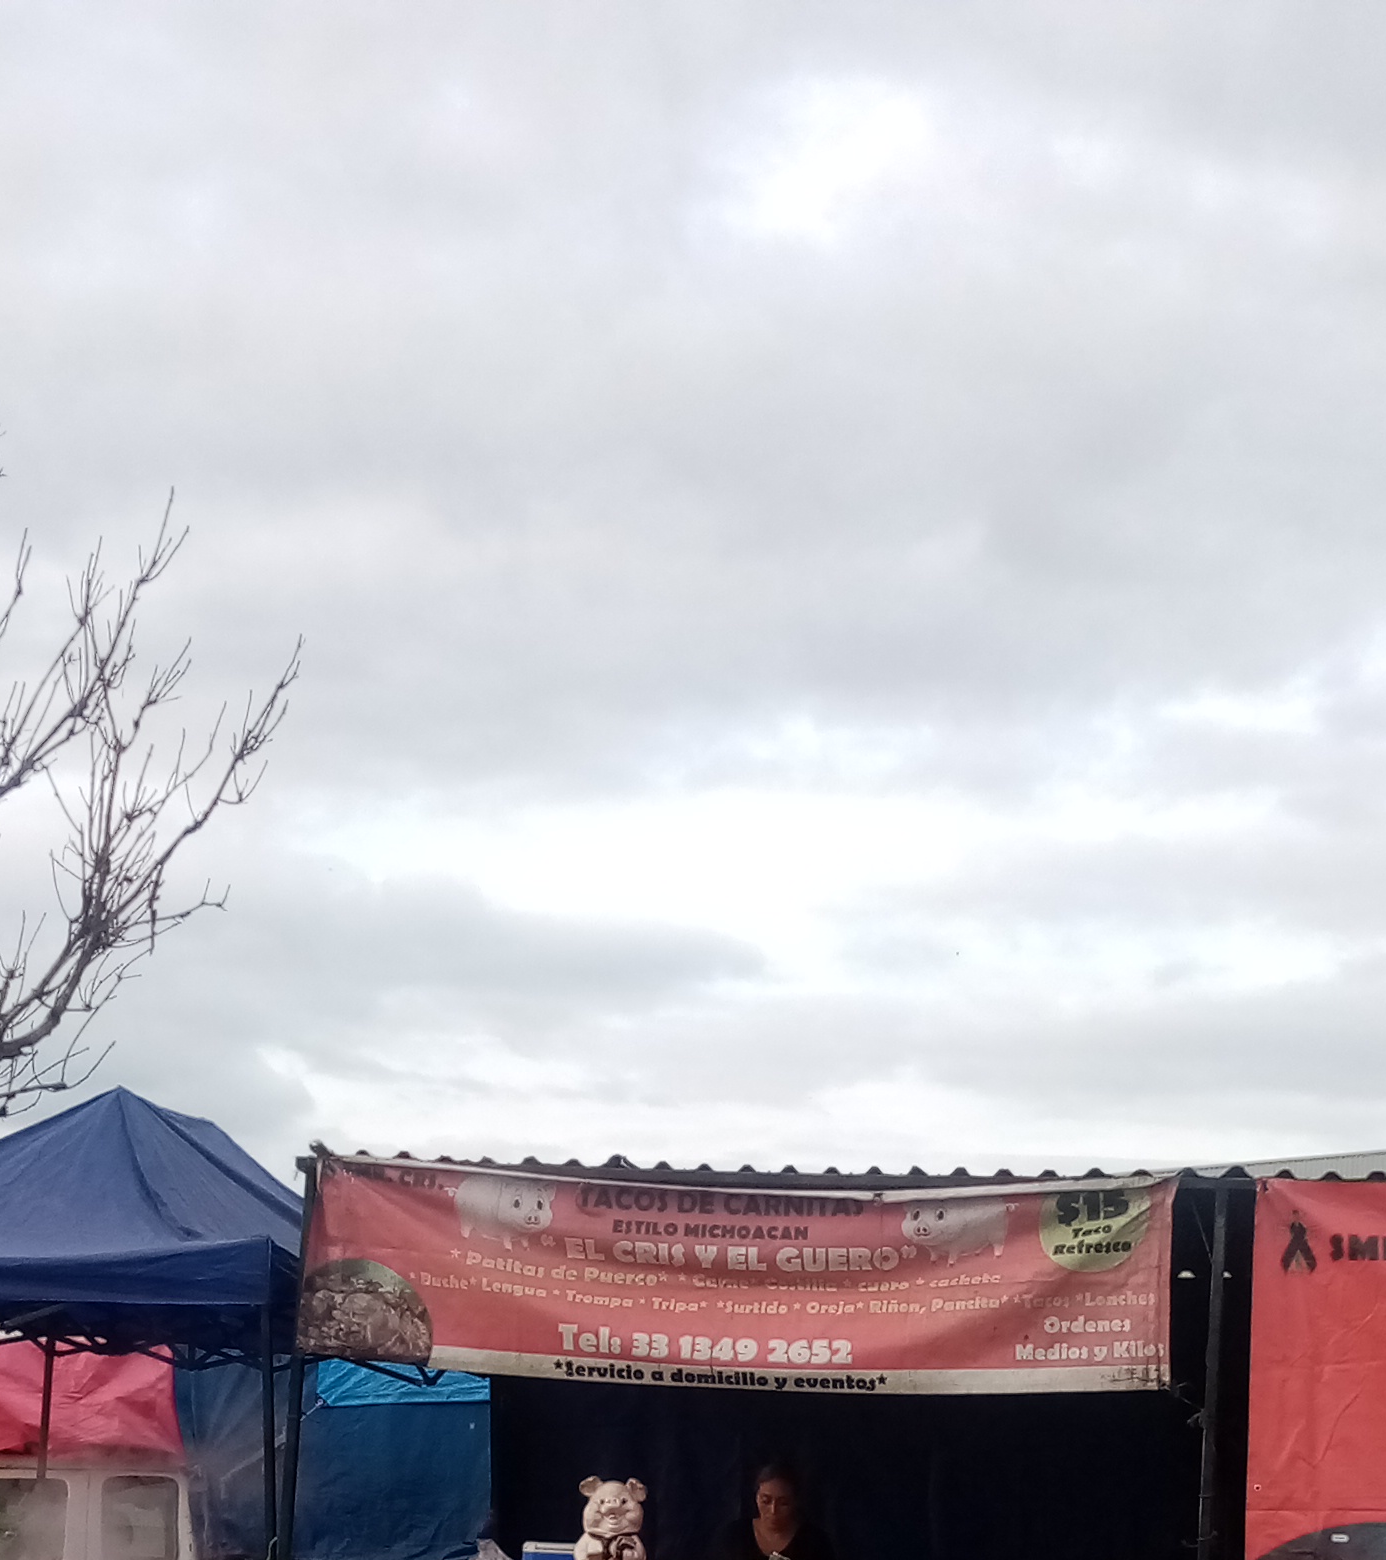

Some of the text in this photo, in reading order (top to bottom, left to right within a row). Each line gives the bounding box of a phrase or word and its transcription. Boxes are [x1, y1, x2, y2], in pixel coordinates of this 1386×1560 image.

[578, 1183, 864, 1217] TACOS DE CARNITAS
[613, 1219, 809, 1241] ESTILO MICHOACAN
[1071, 1224, 1113, 1239] Taco
[564, 1236, 605, 1261] EL
[613, 1240, 686, 1268] CRIS
[694, 1245, 718, 1269] Y
[727, 1246, 767, 1271] EL
[1052, 1240, 1132, 1256] Refresco
[465, 1249, 545, 1279] Patitas
[550, 1263, 577, 1281] de
[856, 1280, 910, 1292] cuero
[929, 1273, 1001, 1288] cachete
[481, 1277, 547, 1297] Lengua
[566, 1289, 633, 1309] Trompa
[1043, 1315, 1131, 1333] Ordenes
[558, 1323, 853, 1364] Tel: 33 1349 2652
[1015, 1340, 1165, 1362] Medios y Kilos
[651, 1369, 664, 1381] a
[671, 1368, 768, 1387] domicilio
[775, 1374, 788, 1389] y
